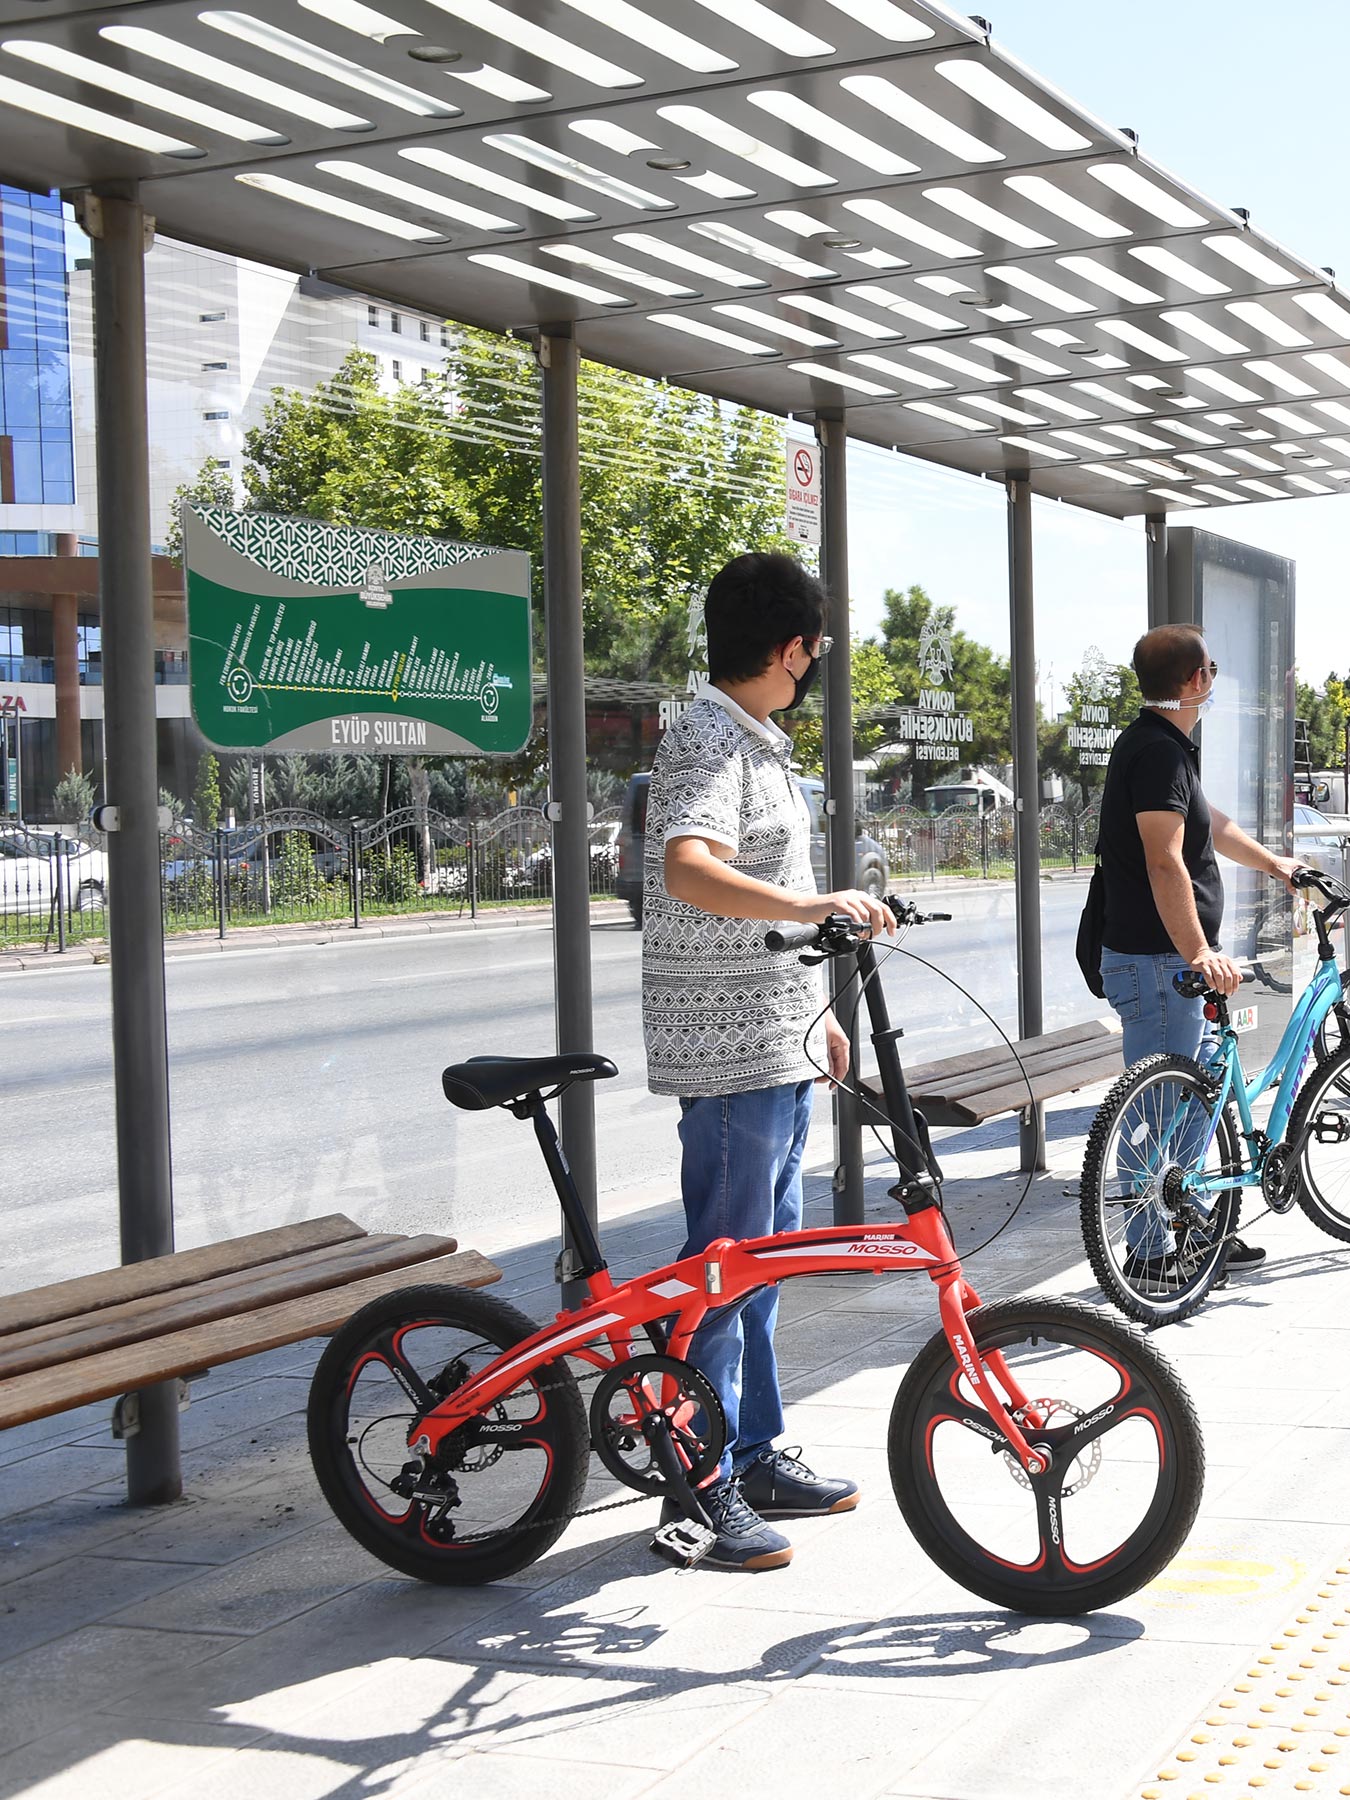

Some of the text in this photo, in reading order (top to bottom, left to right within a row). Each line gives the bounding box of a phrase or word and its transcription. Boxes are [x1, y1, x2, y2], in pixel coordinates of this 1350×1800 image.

[321, 661, 331, 684] SANCAK
[329, 666, 337, 685] JAPON
[0, 696, 27, 712] ZA
[332, 716, 426, 745] EYÜP SULTAN
[1236, 1009, 1253, 1028] AAR
[847, 1244, 917, 1255] MOSSO
[953, 1334, 981, 1385] MARINE
[392, 1367, 424, 1406] MOSSO
[479, 1424, 522, 1432] MOSSO
[962, 1418, 1008, 1443] MOSSO
[1073, 1404, 1114, 1434] MOSSO
[1048, 1496, 1060, 1545] MOSSO
